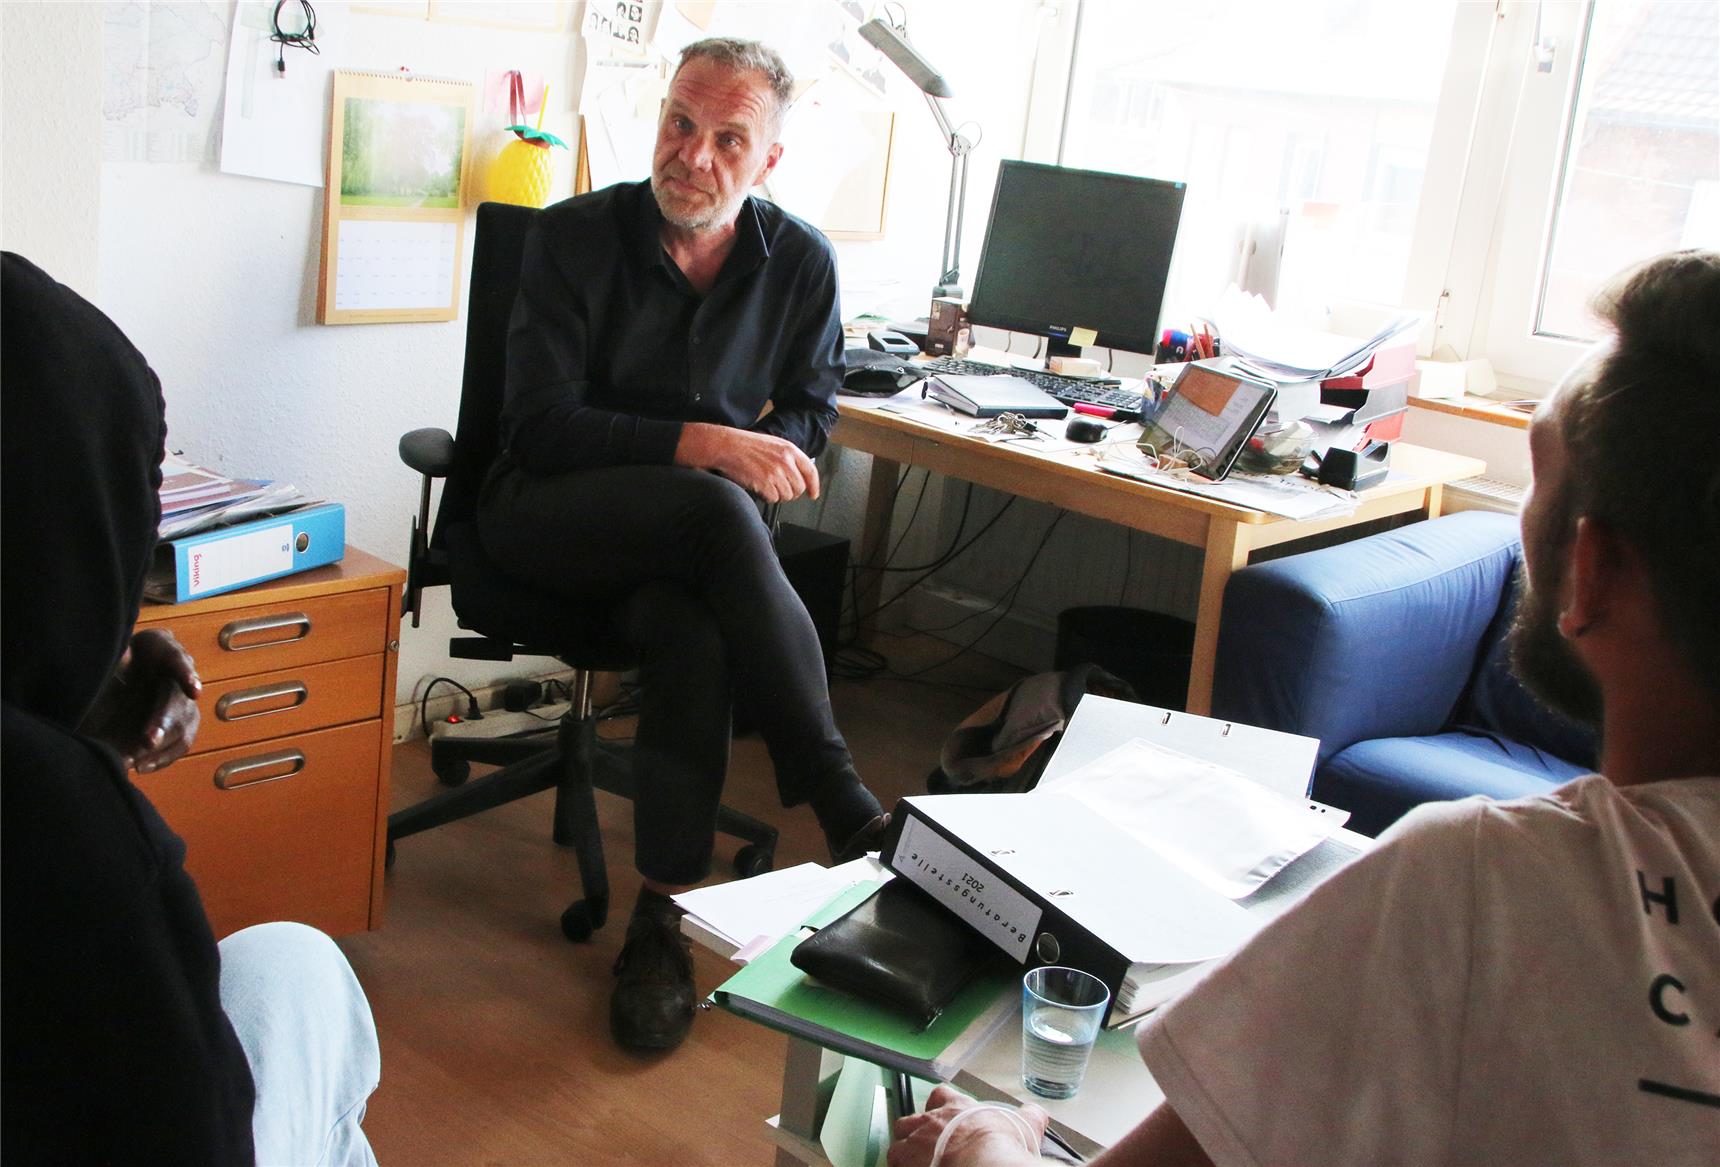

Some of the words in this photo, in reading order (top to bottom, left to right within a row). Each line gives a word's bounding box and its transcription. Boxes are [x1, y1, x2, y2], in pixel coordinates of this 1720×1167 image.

[911, 853, 1027, 943] Beratungsstelle
[961, 872, 985, 894] 2021
[1636, 869, 1720, 925] H
